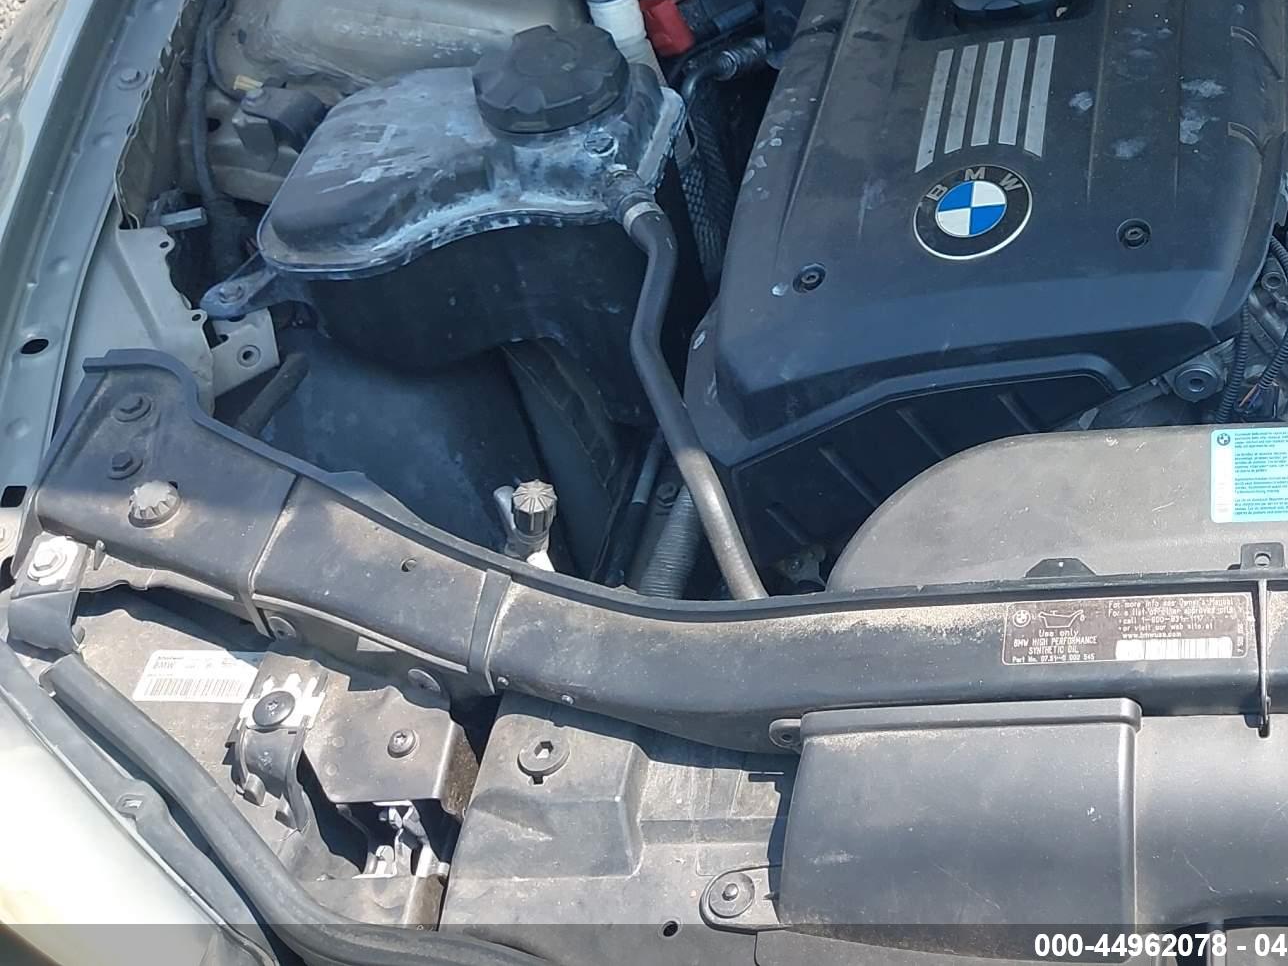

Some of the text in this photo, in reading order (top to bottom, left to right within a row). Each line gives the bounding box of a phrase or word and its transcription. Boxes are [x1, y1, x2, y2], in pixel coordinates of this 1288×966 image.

[927, 167, 1024, 201] BMW
[1122, 616, 1137, 625] call
[1038, 628, 1080, 637] Use only
[1134, 623, 1151, 632] visit
[1013, 635, 1098, 647] BMW HIGH PERFORMANCE
[1028, 645, 1079, 655] SYNTHETIC OIL
[1027, 654, 1039, 663] No.
[1083, 652, 1095, 660] 545
